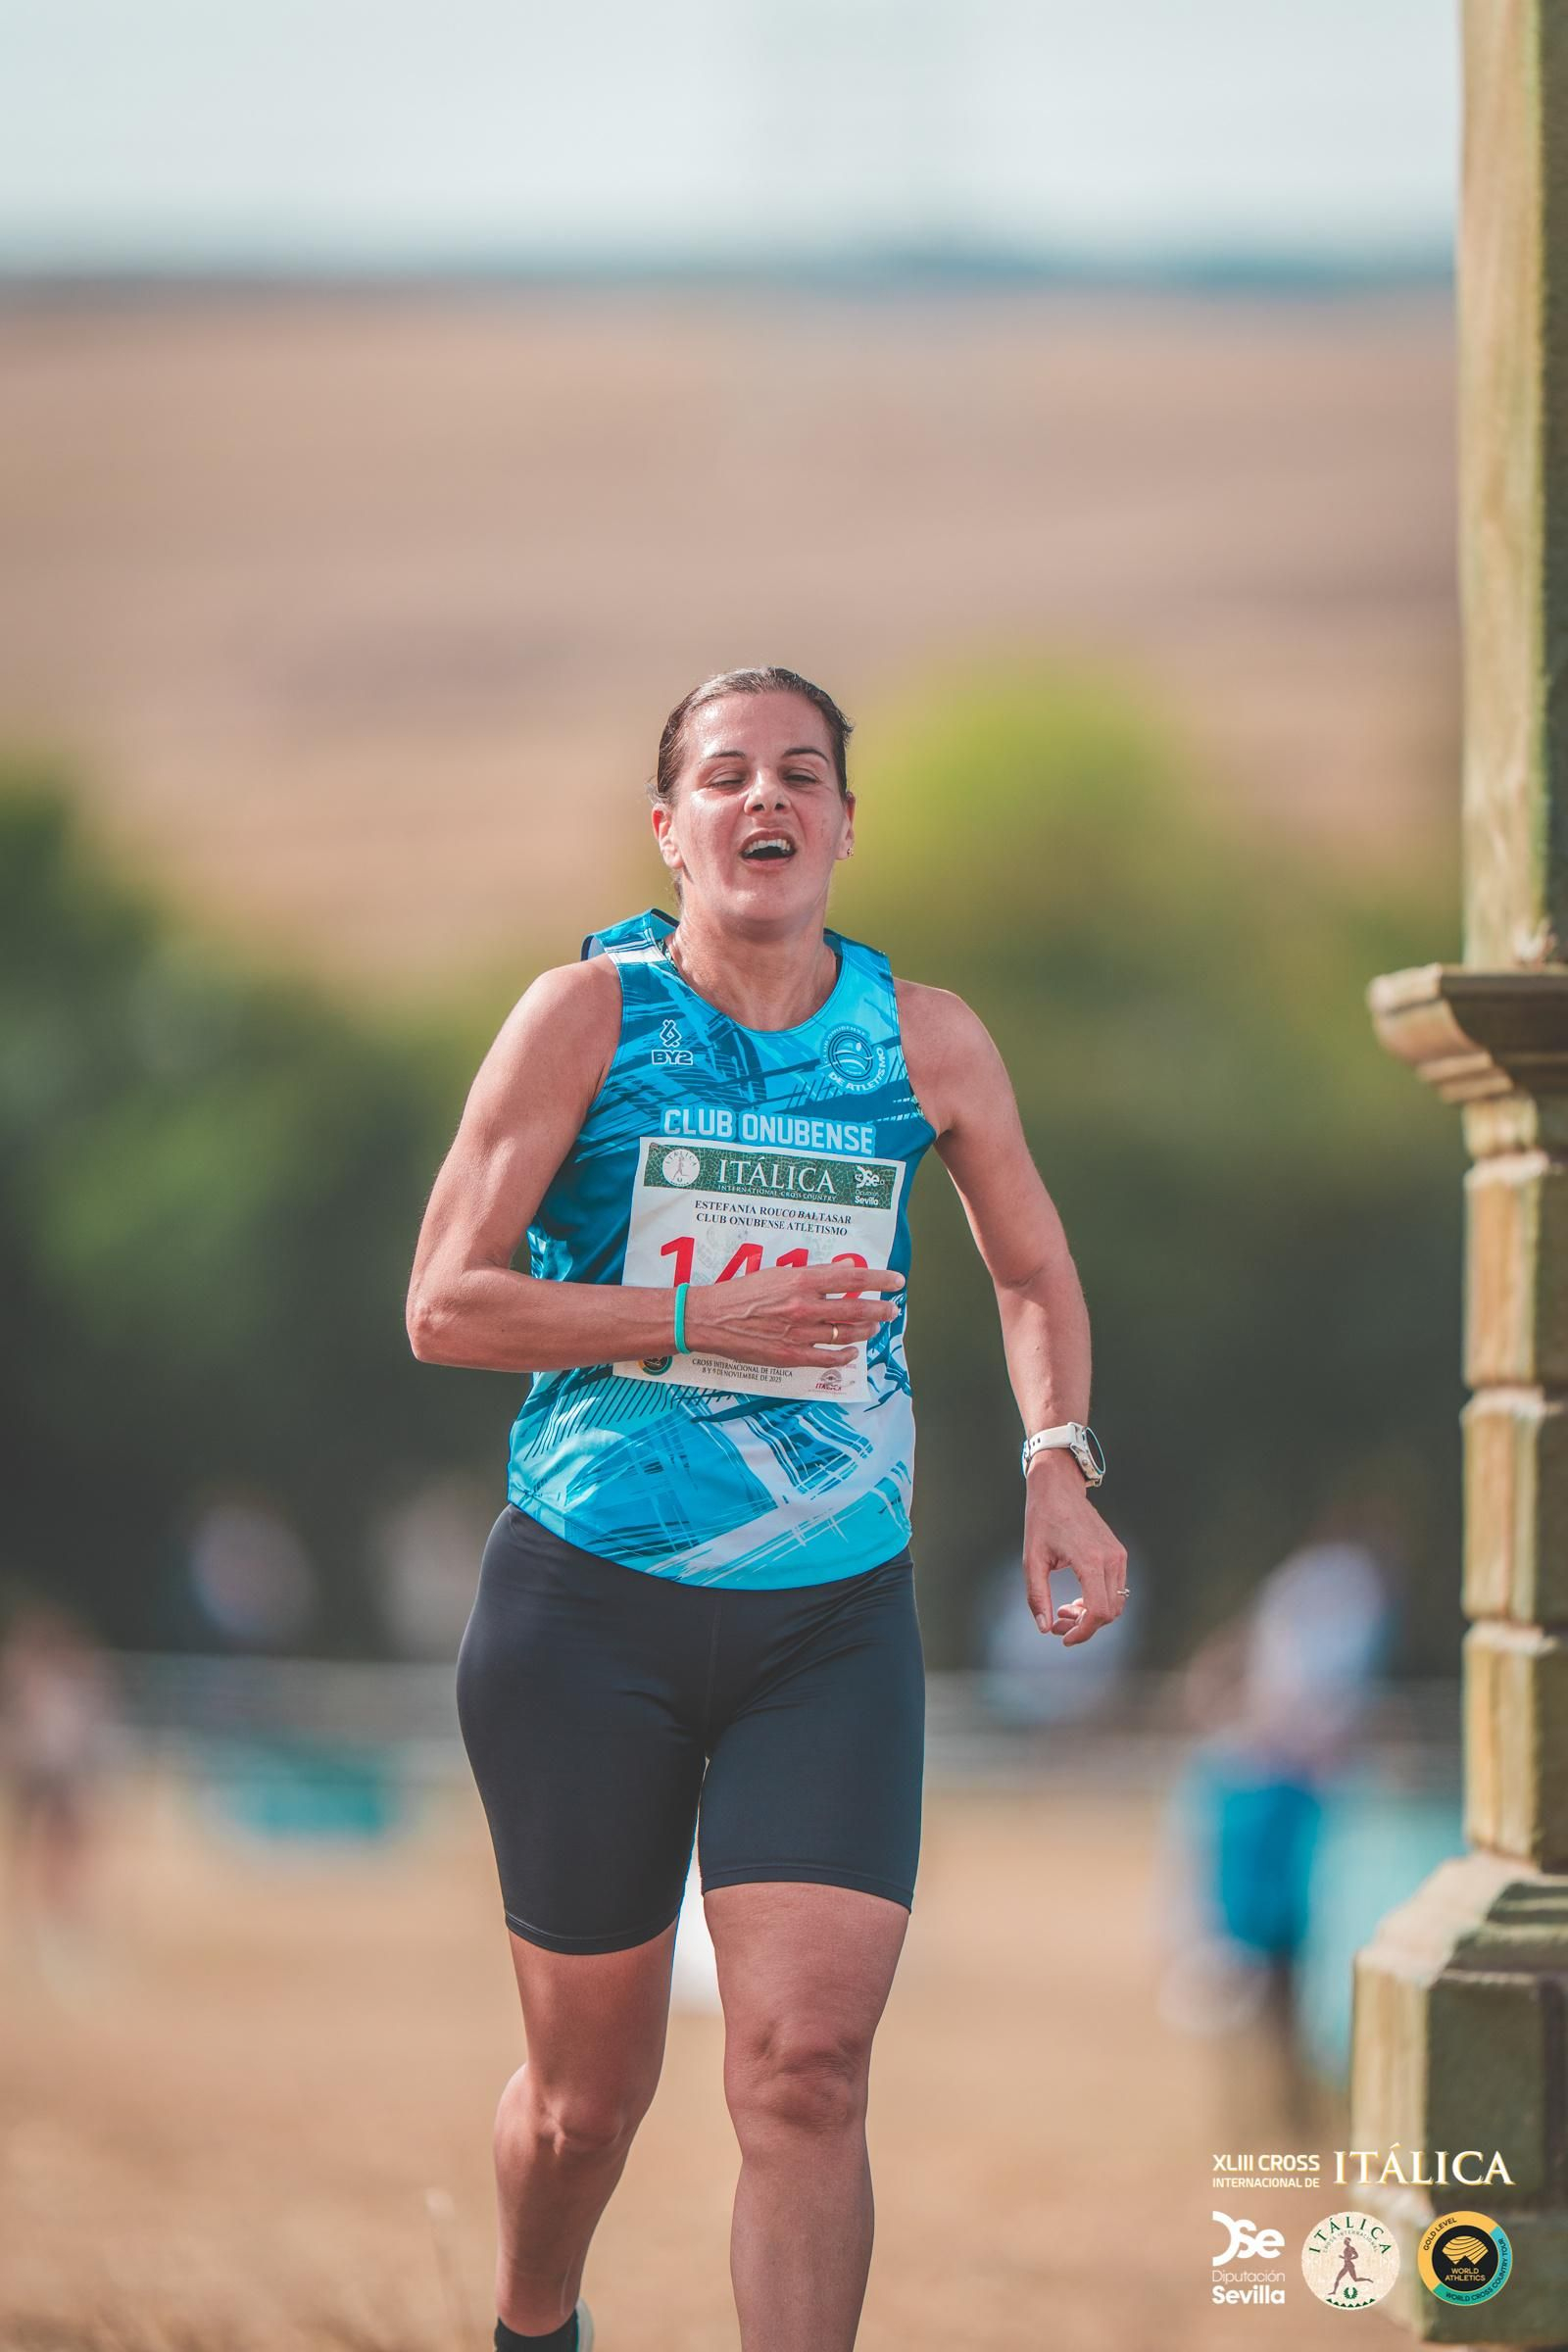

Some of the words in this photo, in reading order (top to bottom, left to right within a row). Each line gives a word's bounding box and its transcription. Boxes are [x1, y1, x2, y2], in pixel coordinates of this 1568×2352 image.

[652, 1050, 694, 1065] BY2
[828, 1071, 846, 1087] DE
[846, 1047, 886, 1092] ATLETISMO
[663, 1108, 733, 1138] CLUB
[742, 1113, 873, 1154] ONUBENSE
[718, 1156, 837, 1195] ITÁLICA
[718, 1184, 777, 1197] INTERNATIONAL
[855, 1195, 879, 1206] Sevilla
[696, 1212, 727, 1224] CLUB
[729, 1215, 785, 1230] ONUBENSE
[787, 1222, 849, 1237] ATLETISMO
[760, 1206, 796, 1219] ROUCO
[798, 1209, 852, 1225] BALTASAR
[692, 1358, 712, 1367] CROSS
[713, 1360, 760, 1374] INTERNACIONAL
[760, 1366, 769, 1375] DE
[724, 1369, 758, 1381] NOVIEMBRE
[769, 1375, 782, 1384] 2025
